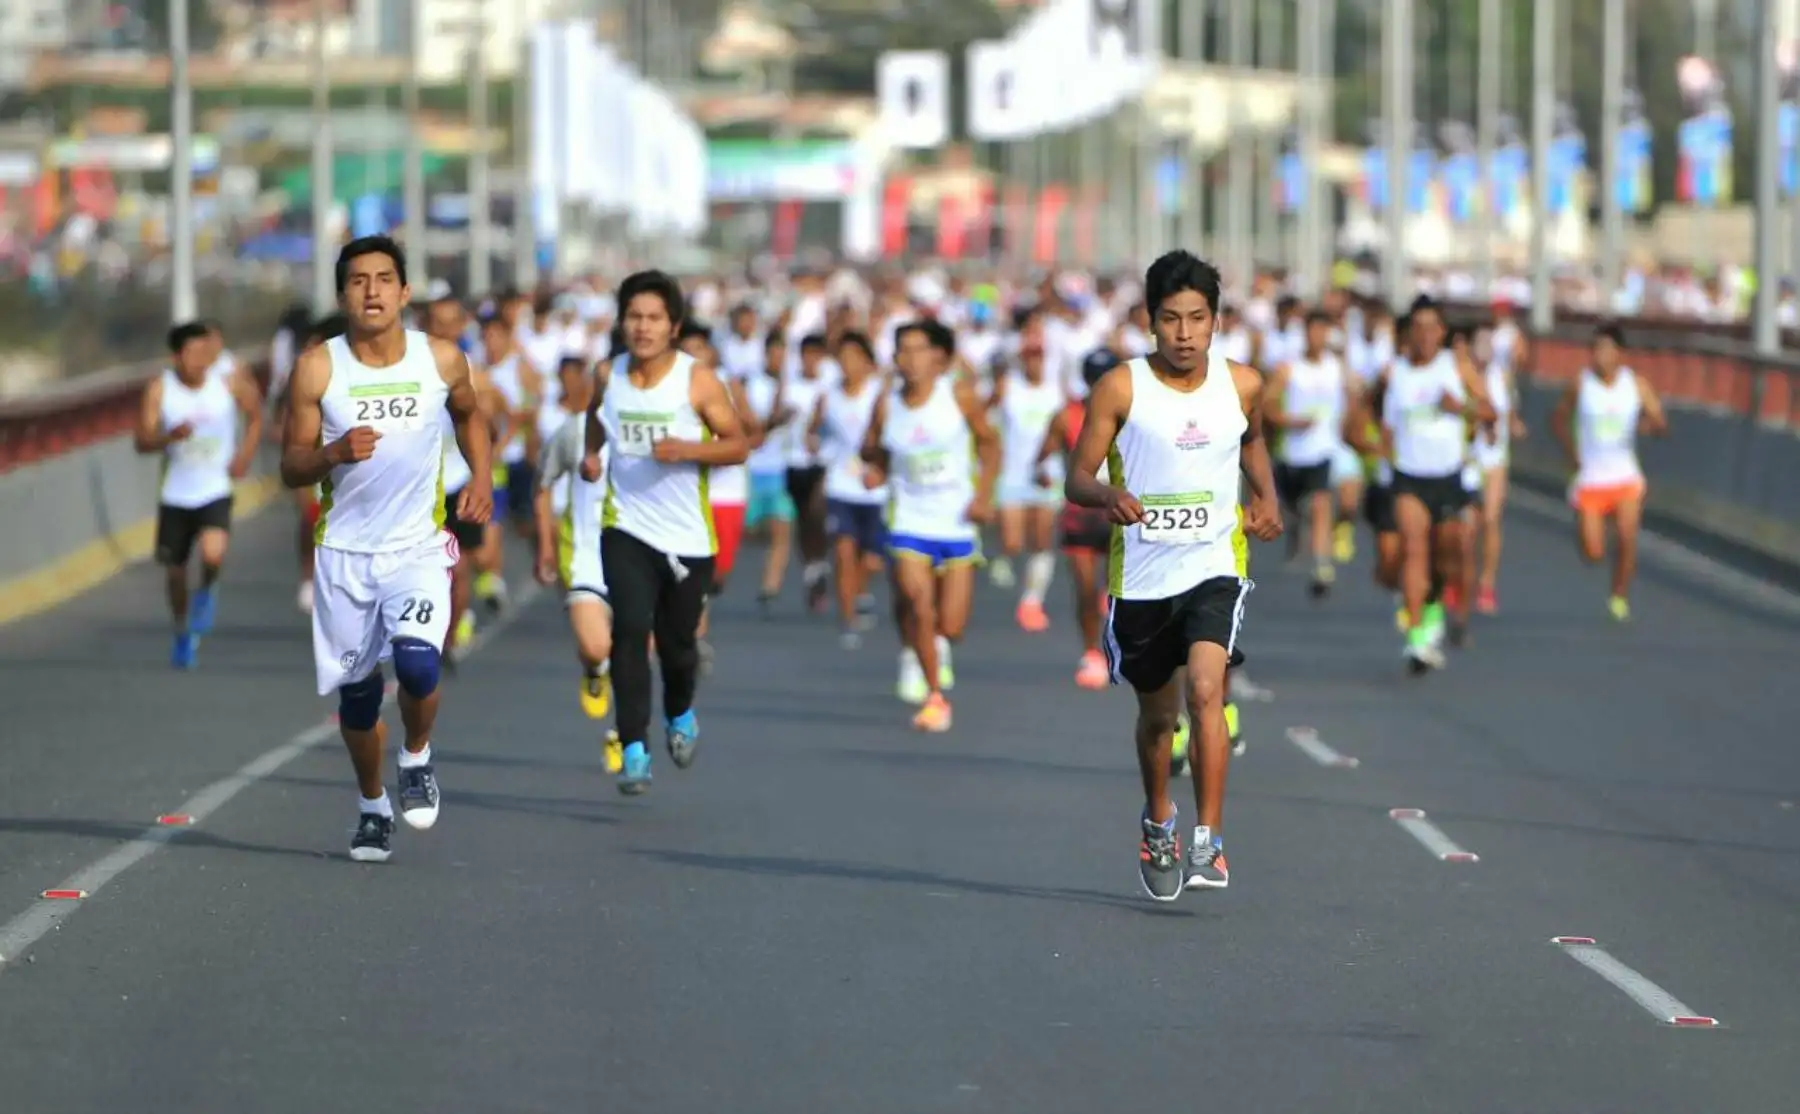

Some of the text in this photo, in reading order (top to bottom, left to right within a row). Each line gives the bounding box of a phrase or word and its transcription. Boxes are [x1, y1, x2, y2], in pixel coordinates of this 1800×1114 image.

[356, 397, 418, 421] 2362
[1146, 507, 1208, 529] 2529
[398, 597, 434, 624] 28
